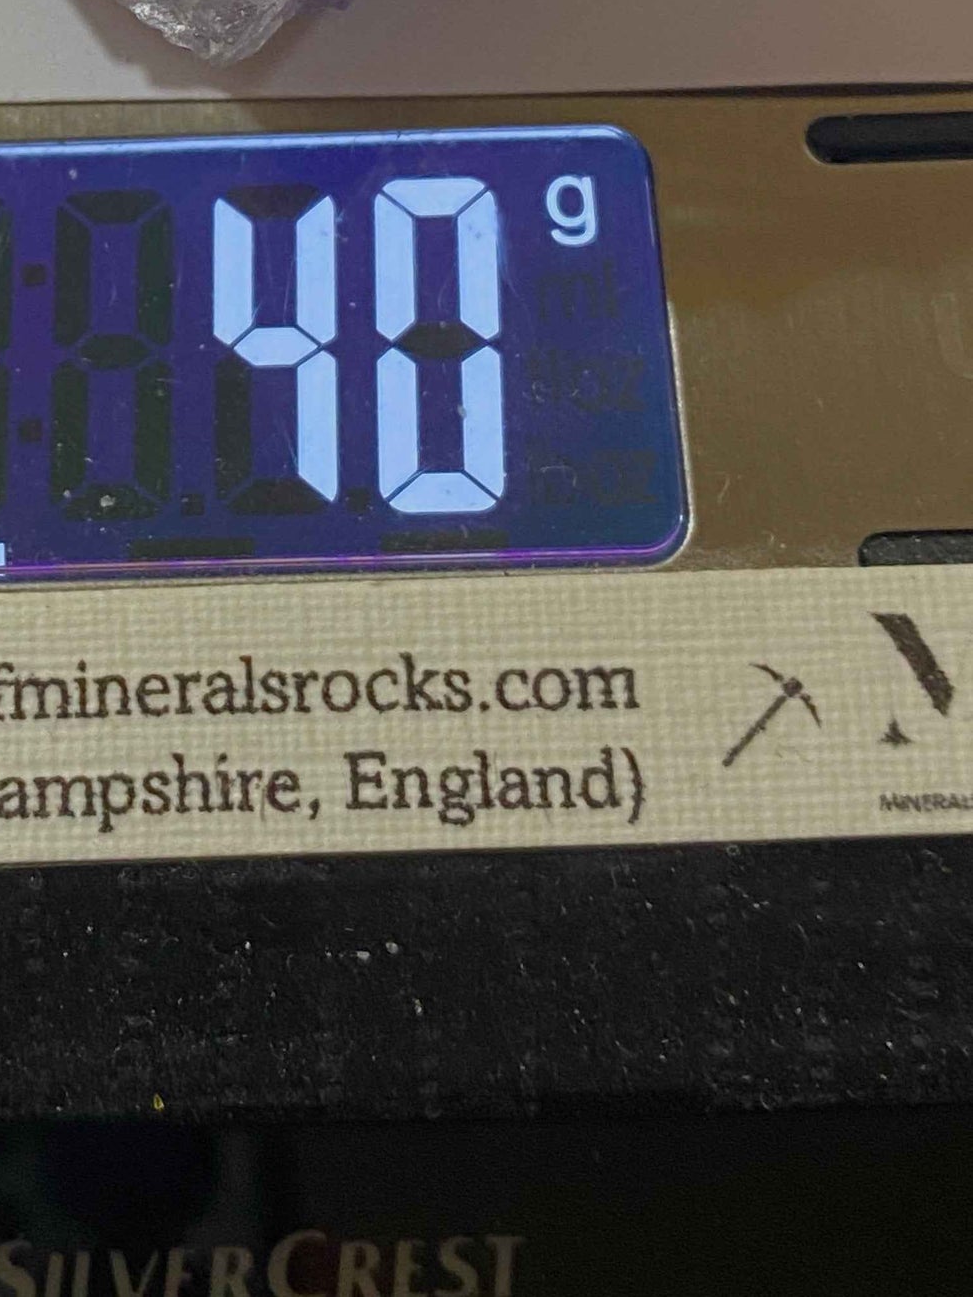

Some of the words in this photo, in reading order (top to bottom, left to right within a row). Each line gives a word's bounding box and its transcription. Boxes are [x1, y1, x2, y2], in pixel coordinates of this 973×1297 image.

[213, 176, 505, 513] 40
[545, 174, 599, 248] g
[343, 747, 646, 828] England)
[880, 792, 973, 813] MINERAL
